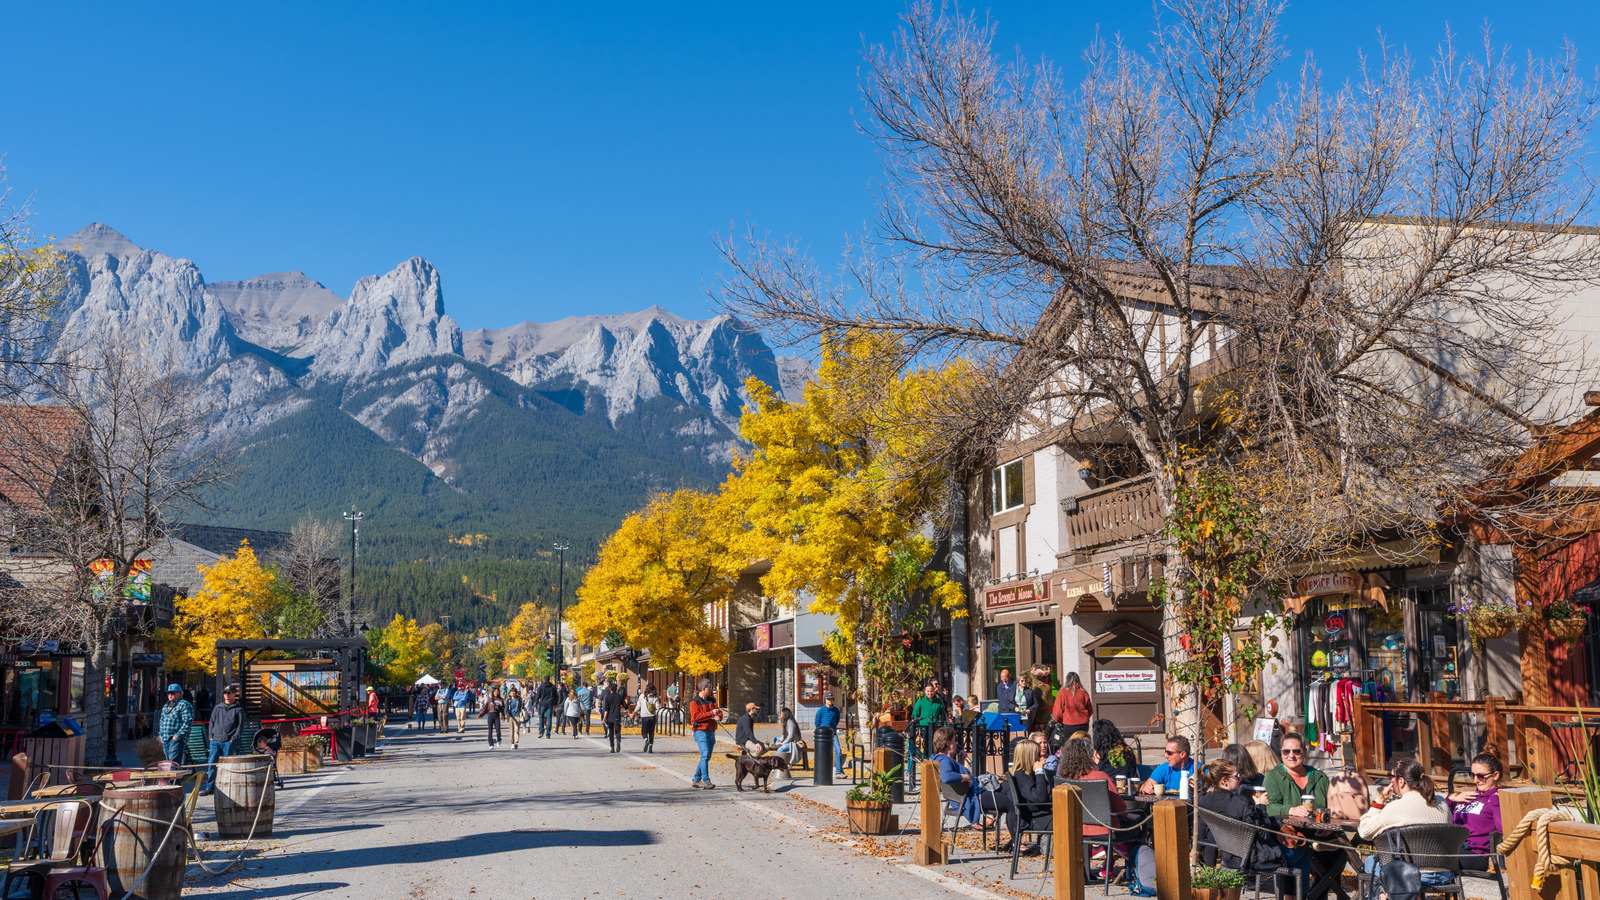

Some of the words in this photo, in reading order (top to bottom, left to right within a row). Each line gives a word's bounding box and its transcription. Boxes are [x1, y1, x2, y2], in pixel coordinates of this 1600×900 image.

[1302, 577, 1330, 591] VENICE
[1333, 573, 1357, 587] GIFTS
[989, 592, 998, 605] The
[1018, 588, 1033, 600] Moose
[1325, 617, 1345, 630] OPEN
